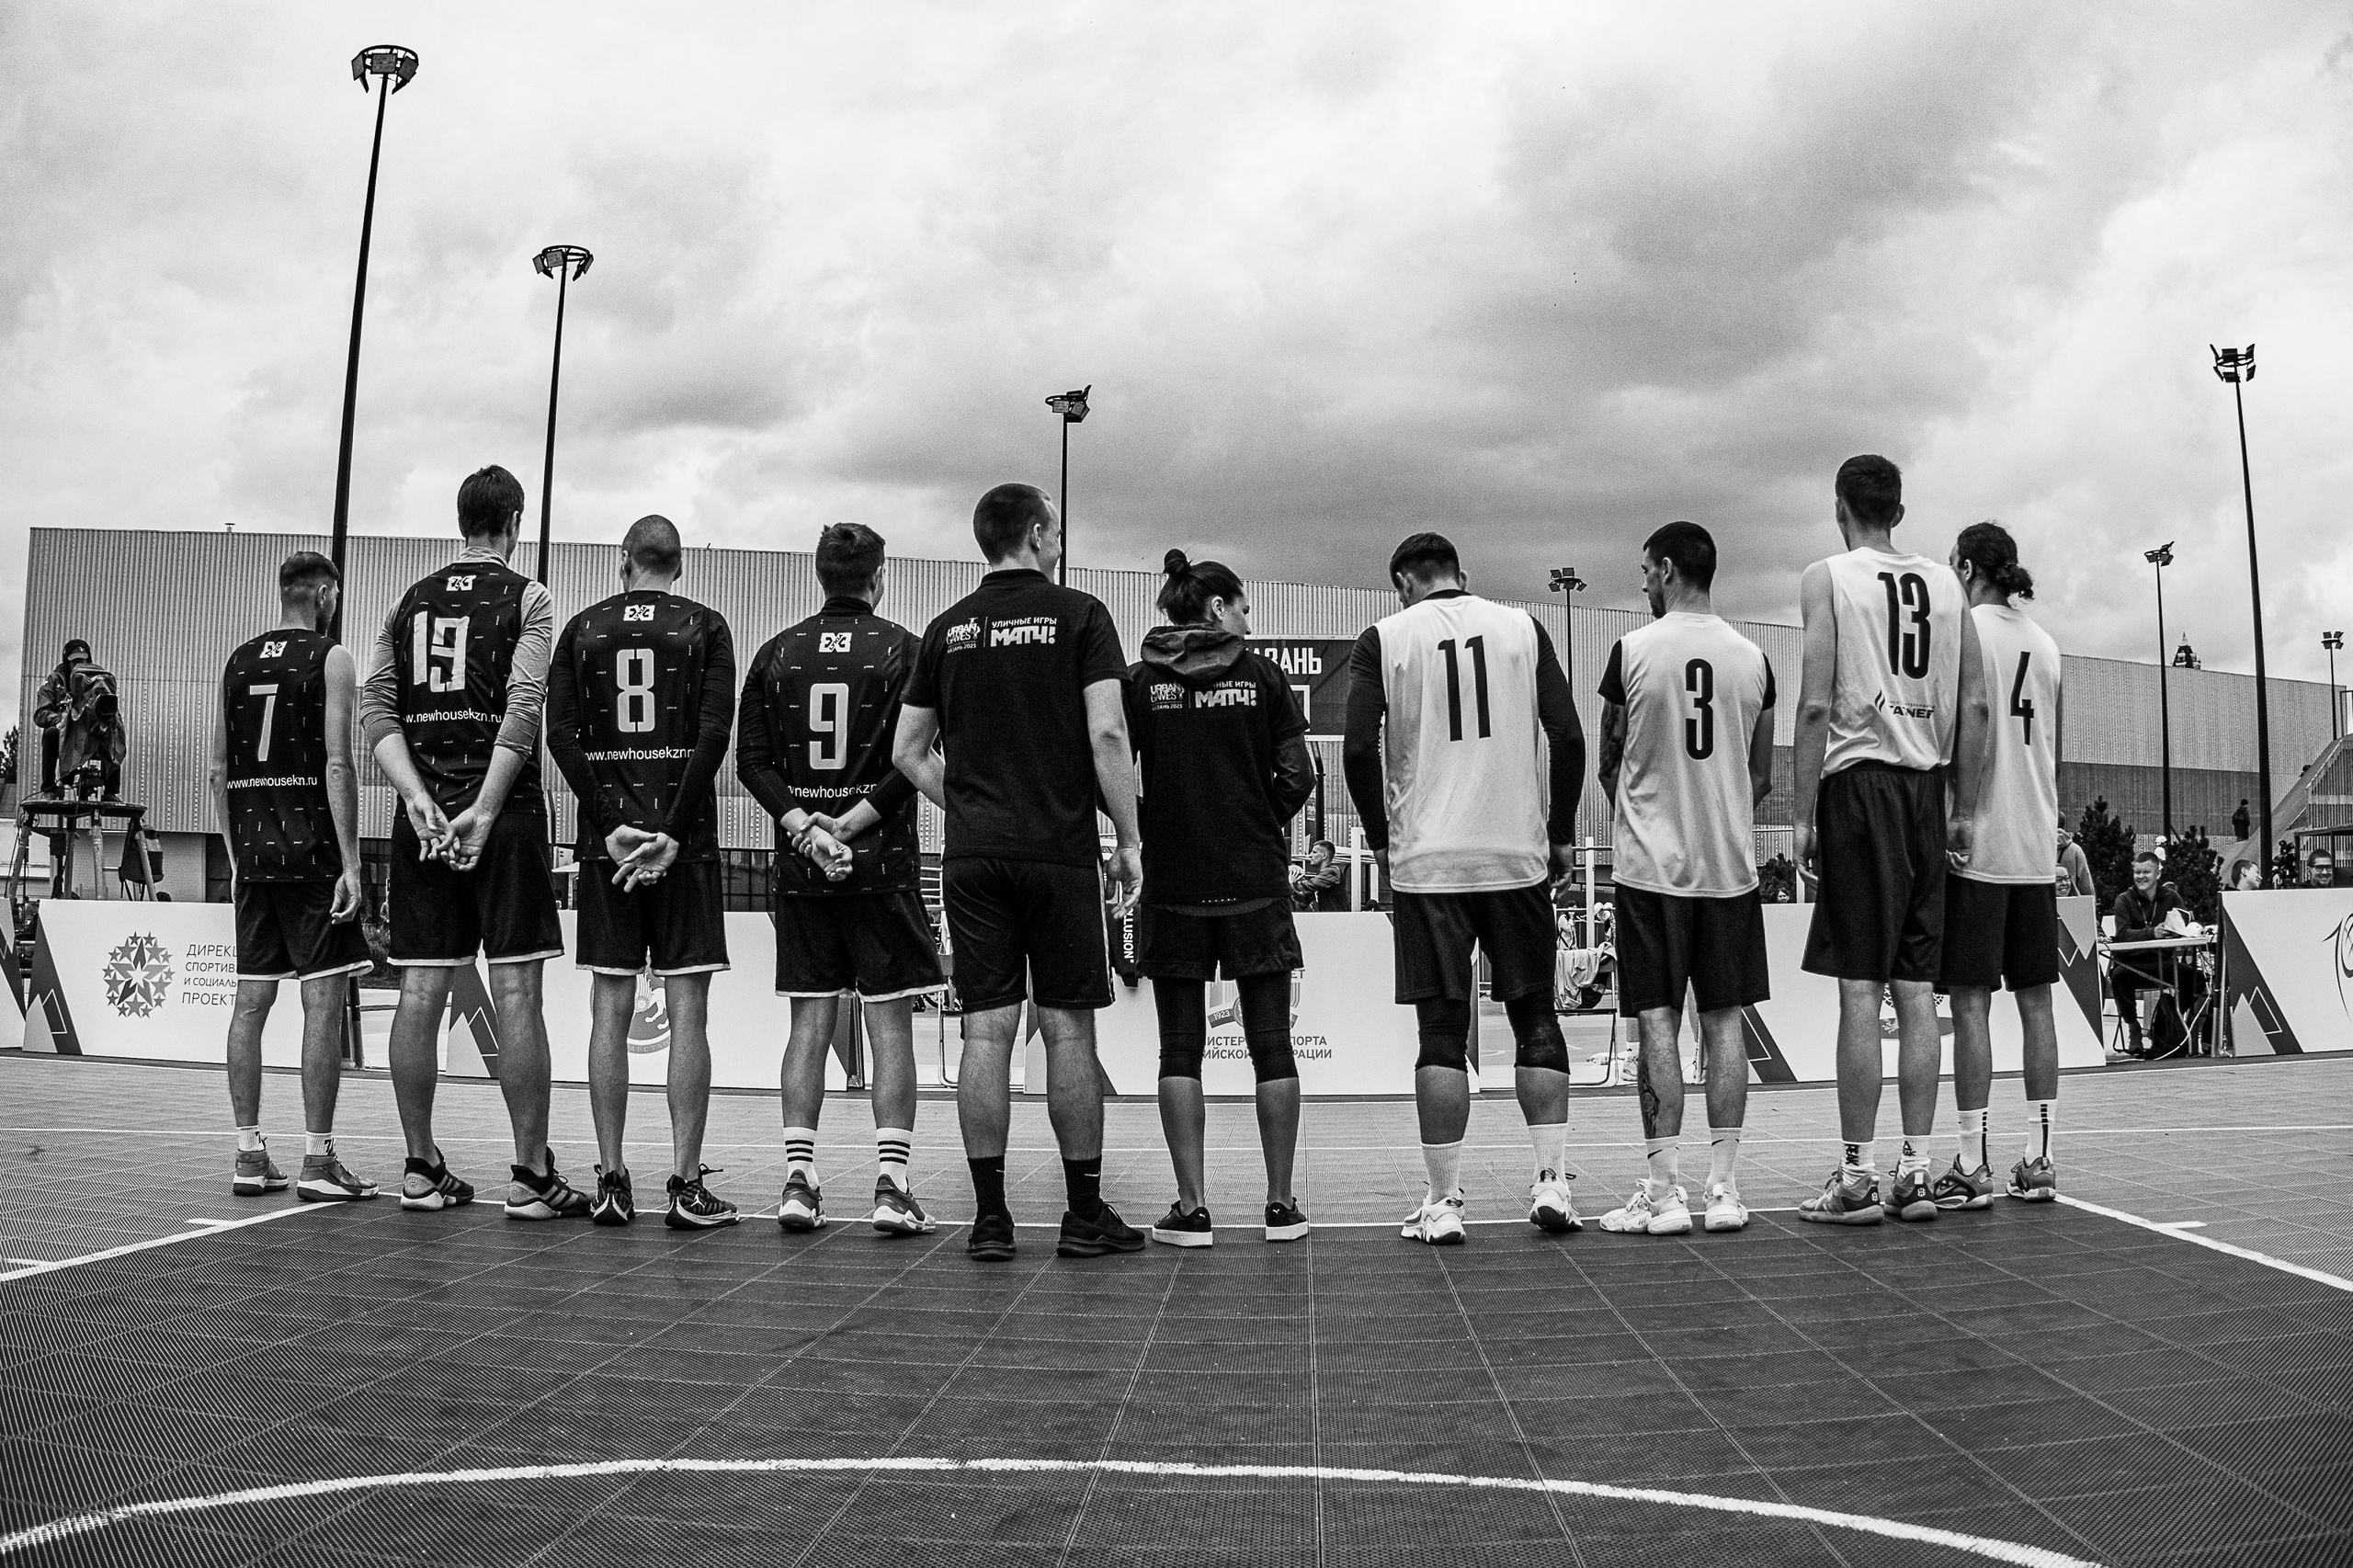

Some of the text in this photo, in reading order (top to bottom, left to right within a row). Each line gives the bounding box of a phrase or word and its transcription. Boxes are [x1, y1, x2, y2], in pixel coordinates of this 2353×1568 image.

[990, 626, 1056, 647] МАТЧ!
[992, 617, 1057, 629] УЛИЧНЫЕ ИГРЫ
[1878, 572, 1930, 679] 13
[414, 610, 470, 692] 19
[1245, 647, 1322, 675] ЗАНЬ
[617, 648, 655, 733] 8
[1195, 688, 1257, 709] МАТЧ!
[1438, 635, 1491, 742] 11
[2010, 651, 2034, 745] 4
[249, 683, 278, 762] 7
[403, 707, 503, 723] w.newhousekzn.ru
[1685, 658, 1713, 760] 3
[809, 683, 849, 769] 9
[186, 962, 235, 972] СПОРТИВ
[184, 977, 237, 987] И СОЦИАЛЬ
[182, 993, 236, 1006] ПРОЕКТ
[1213, 1010, 1231, 1020] 1923
